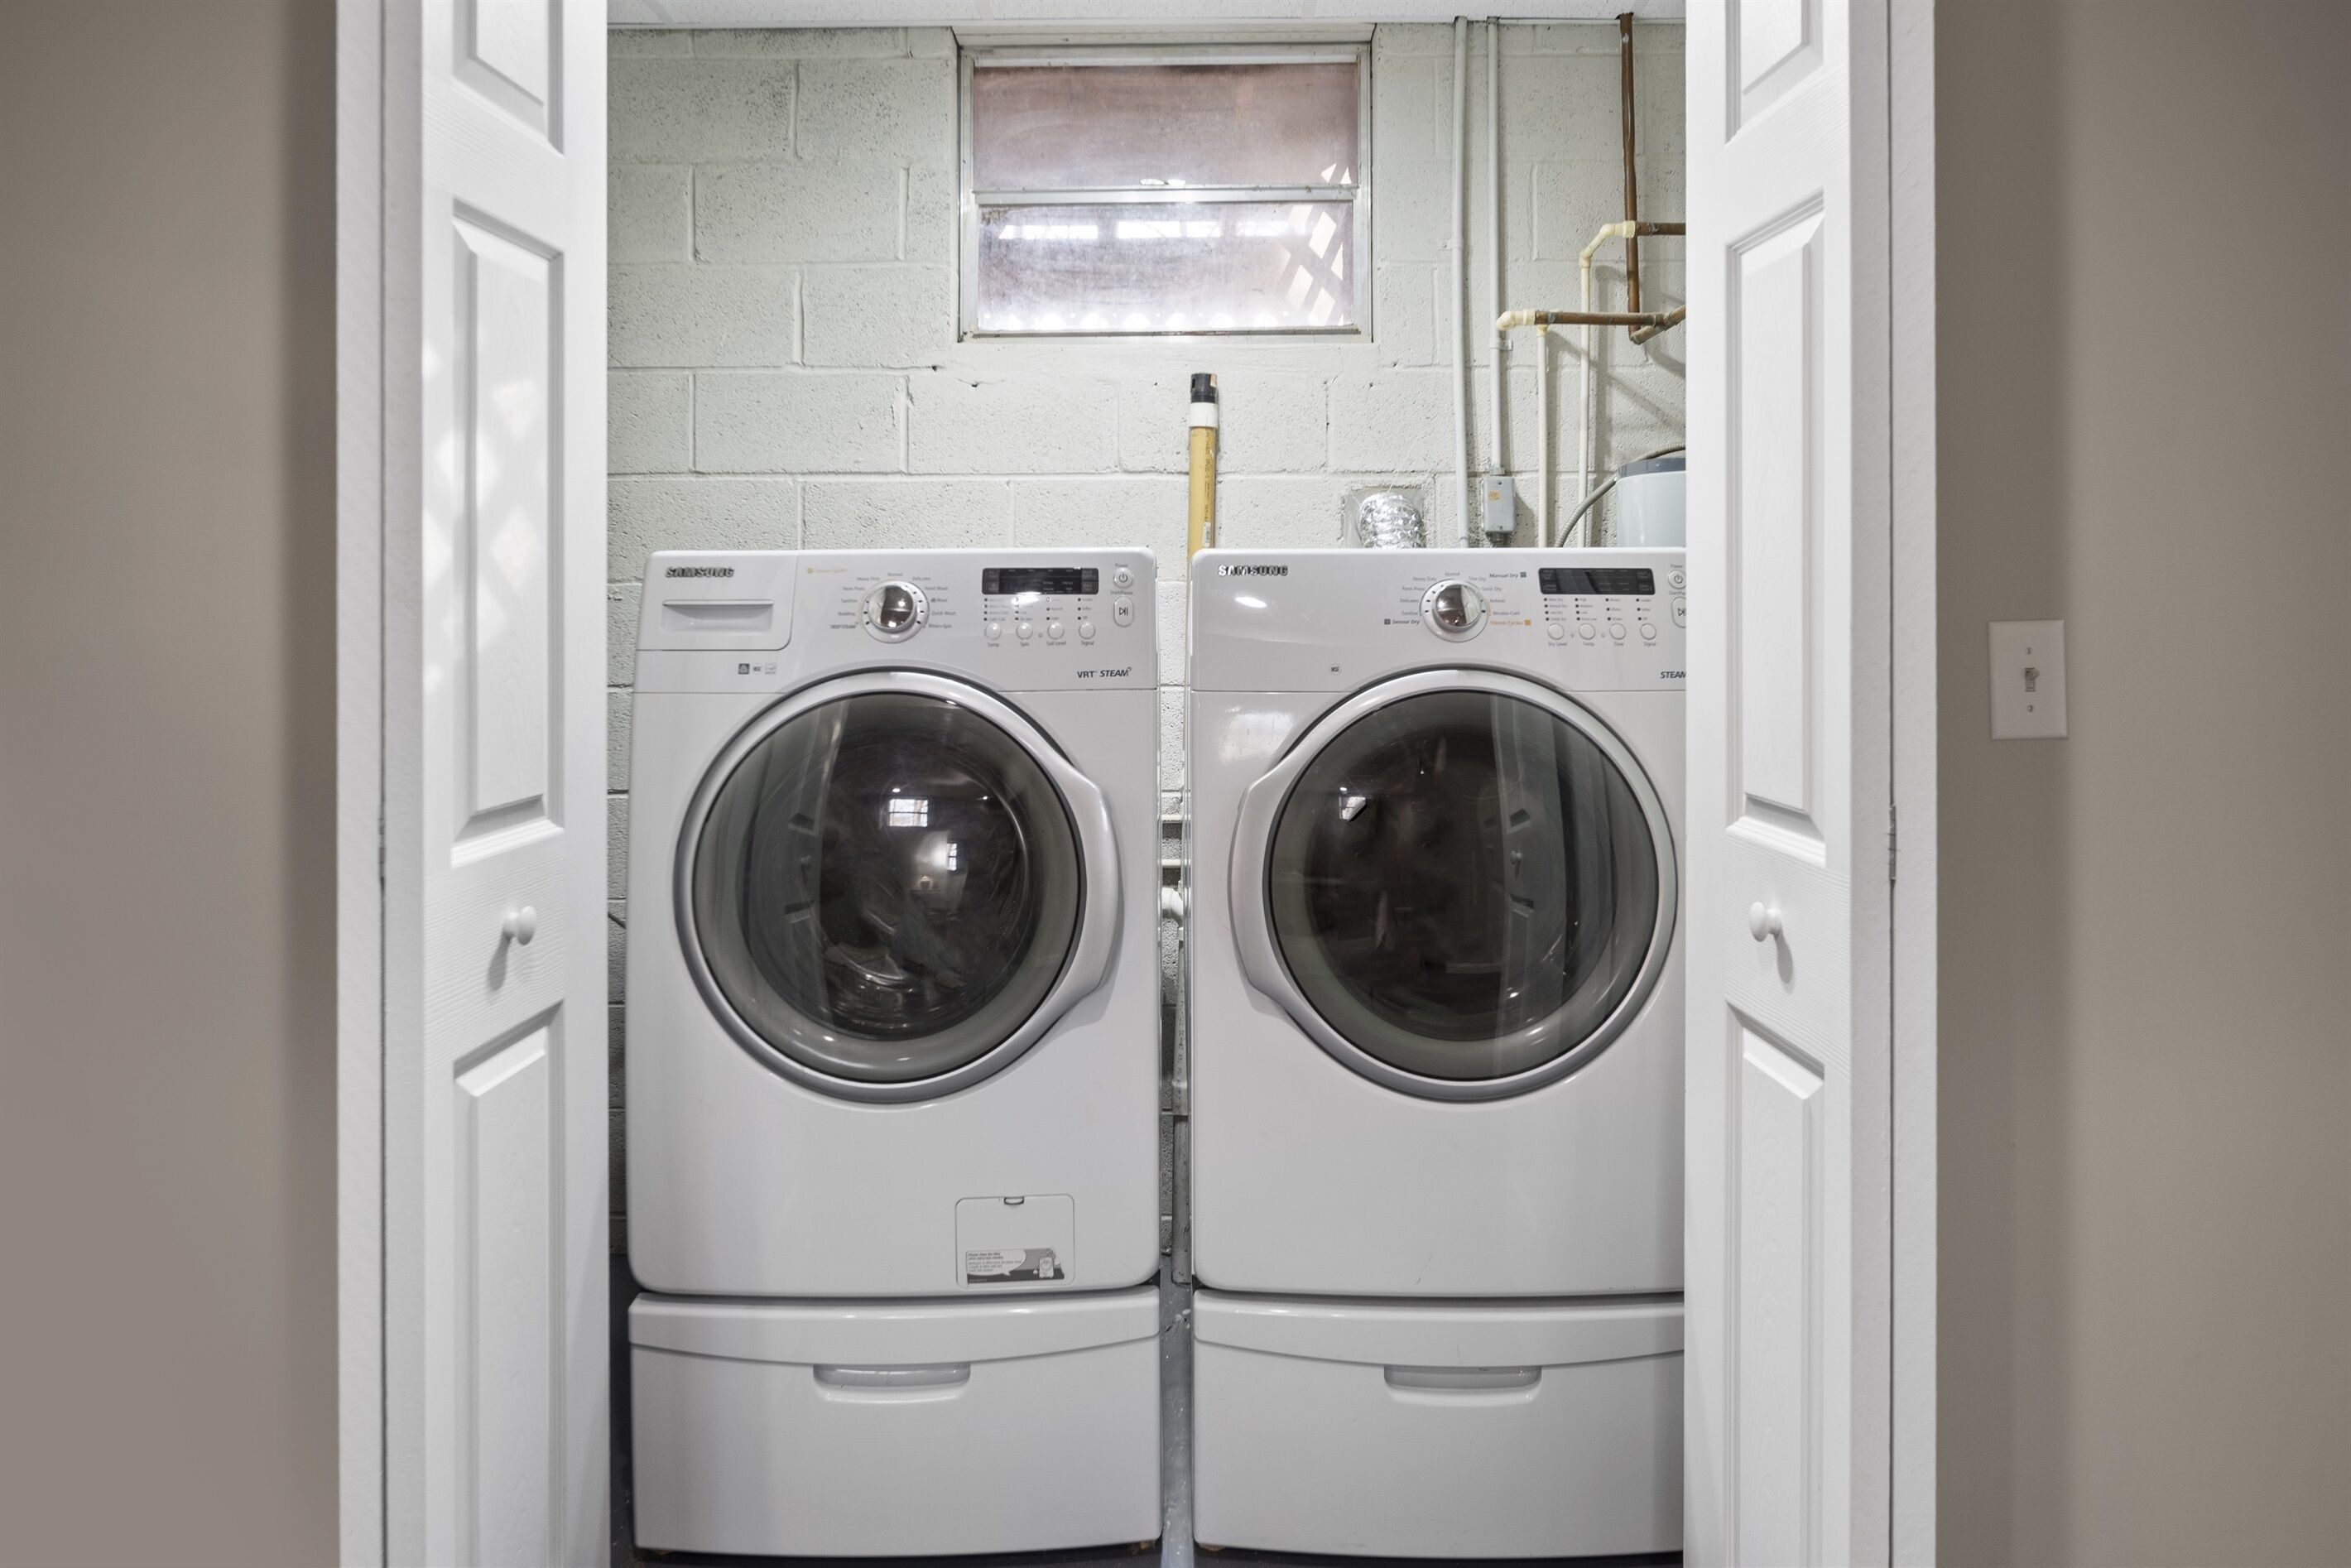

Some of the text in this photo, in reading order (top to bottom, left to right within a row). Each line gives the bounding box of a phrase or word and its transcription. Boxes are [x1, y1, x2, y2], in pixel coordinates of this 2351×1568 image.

[665, 566, 734, 578] SAMSUNG
[1218, 565, 1288, 576] SAMSUNG
[1100, 668, 1131, 677] STEAM
